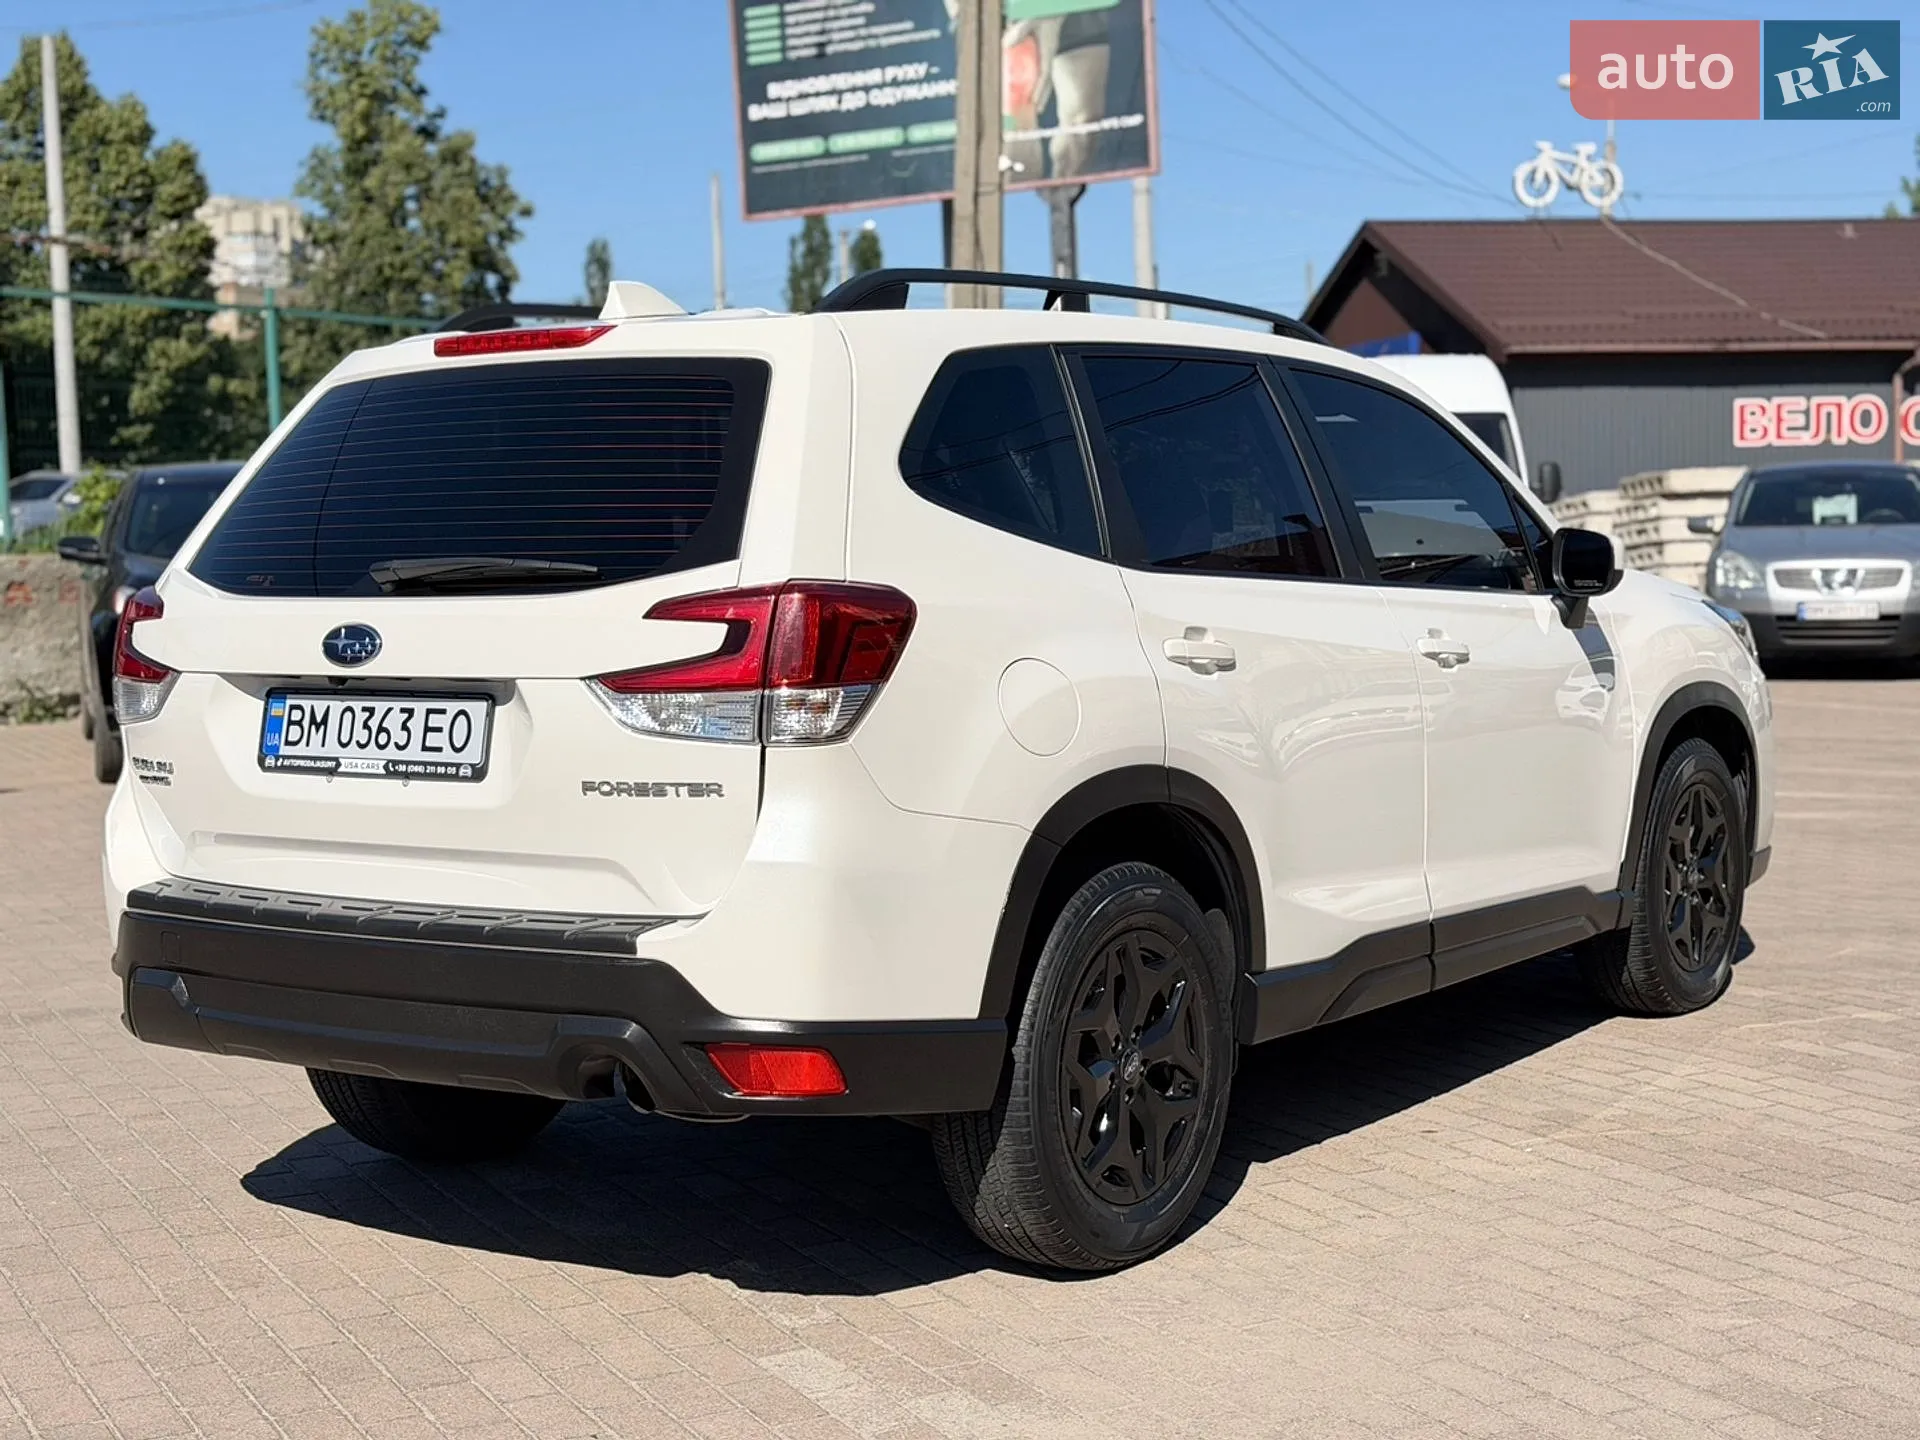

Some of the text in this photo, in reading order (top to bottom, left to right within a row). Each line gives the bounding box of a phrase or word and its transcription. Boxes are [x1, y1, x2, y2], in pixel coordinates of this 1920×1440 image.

[884, 61, 929, 83] РУХУ
[748, 100, 788, 121] ВАШ
[839, 90, 867, 112] ДО
[1733, 394, 1888, 447] ВЕЛО
[284, 703, 473, 753] BM 0363 EO
[265, 732, 280, 747] UA
[343, 761, 380, 771] USA CARS
[581, 780, 725, 798] FORESTER
